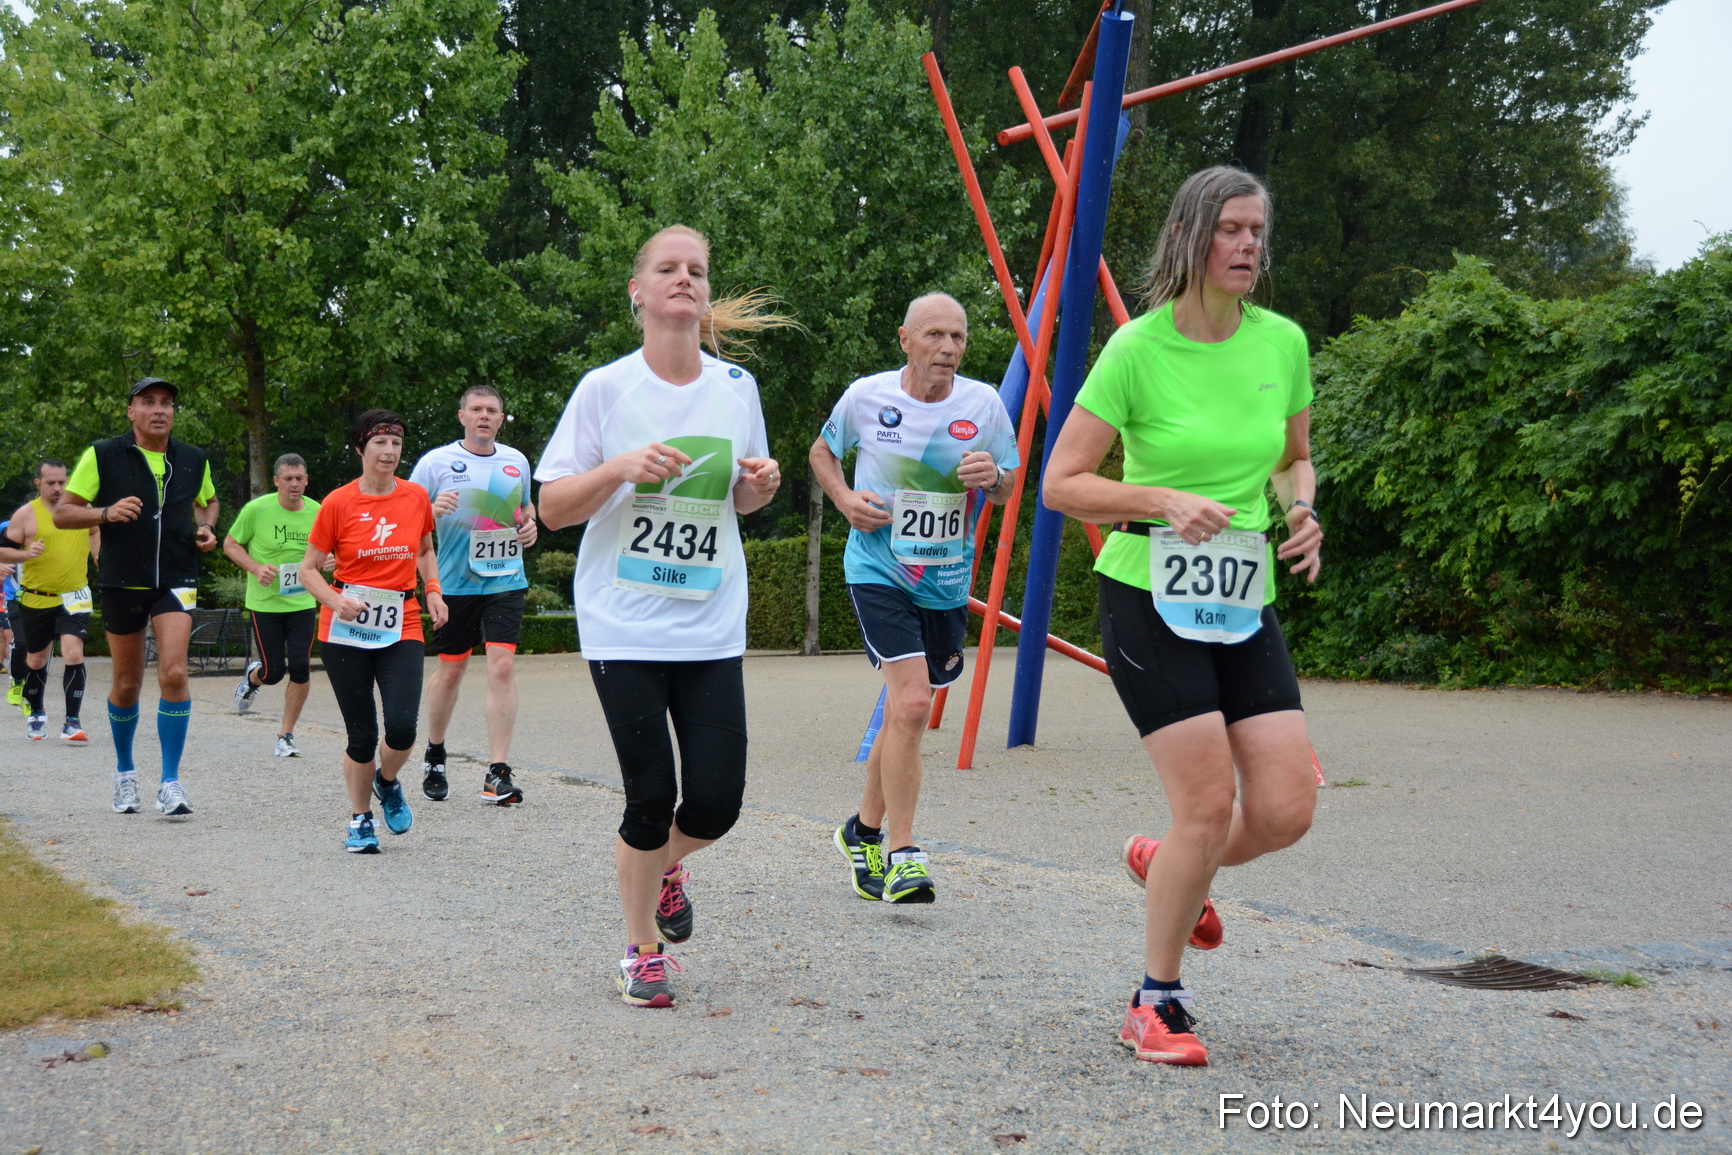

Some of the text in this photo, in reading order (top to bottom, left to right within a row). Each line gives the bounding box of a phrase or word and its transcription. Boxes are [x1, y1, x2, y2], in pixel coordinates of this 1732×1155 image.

[877, 431, 902, 439] PARTL
[632, 503, 667, 512] NeuerMarkt
[673, 501, 721, 516] BOCK
[901, 509, 961, 539] 2016
[630, 516, 718, 562] 2434
[358, 546, 409, 559] funrunners
[374, 552, 414, 561] neumarkt
[475, 540, 518, 559] 2115
[913, 544, 948, 557] Ludwig
[487, 562, 506, 570] Frank
[652, 566, 687, 585] Silke
[1164, 554, 1259, 601] 2307
[352, 601, 398, 629] 613
[349, 627, 382, 642] Brigitte
